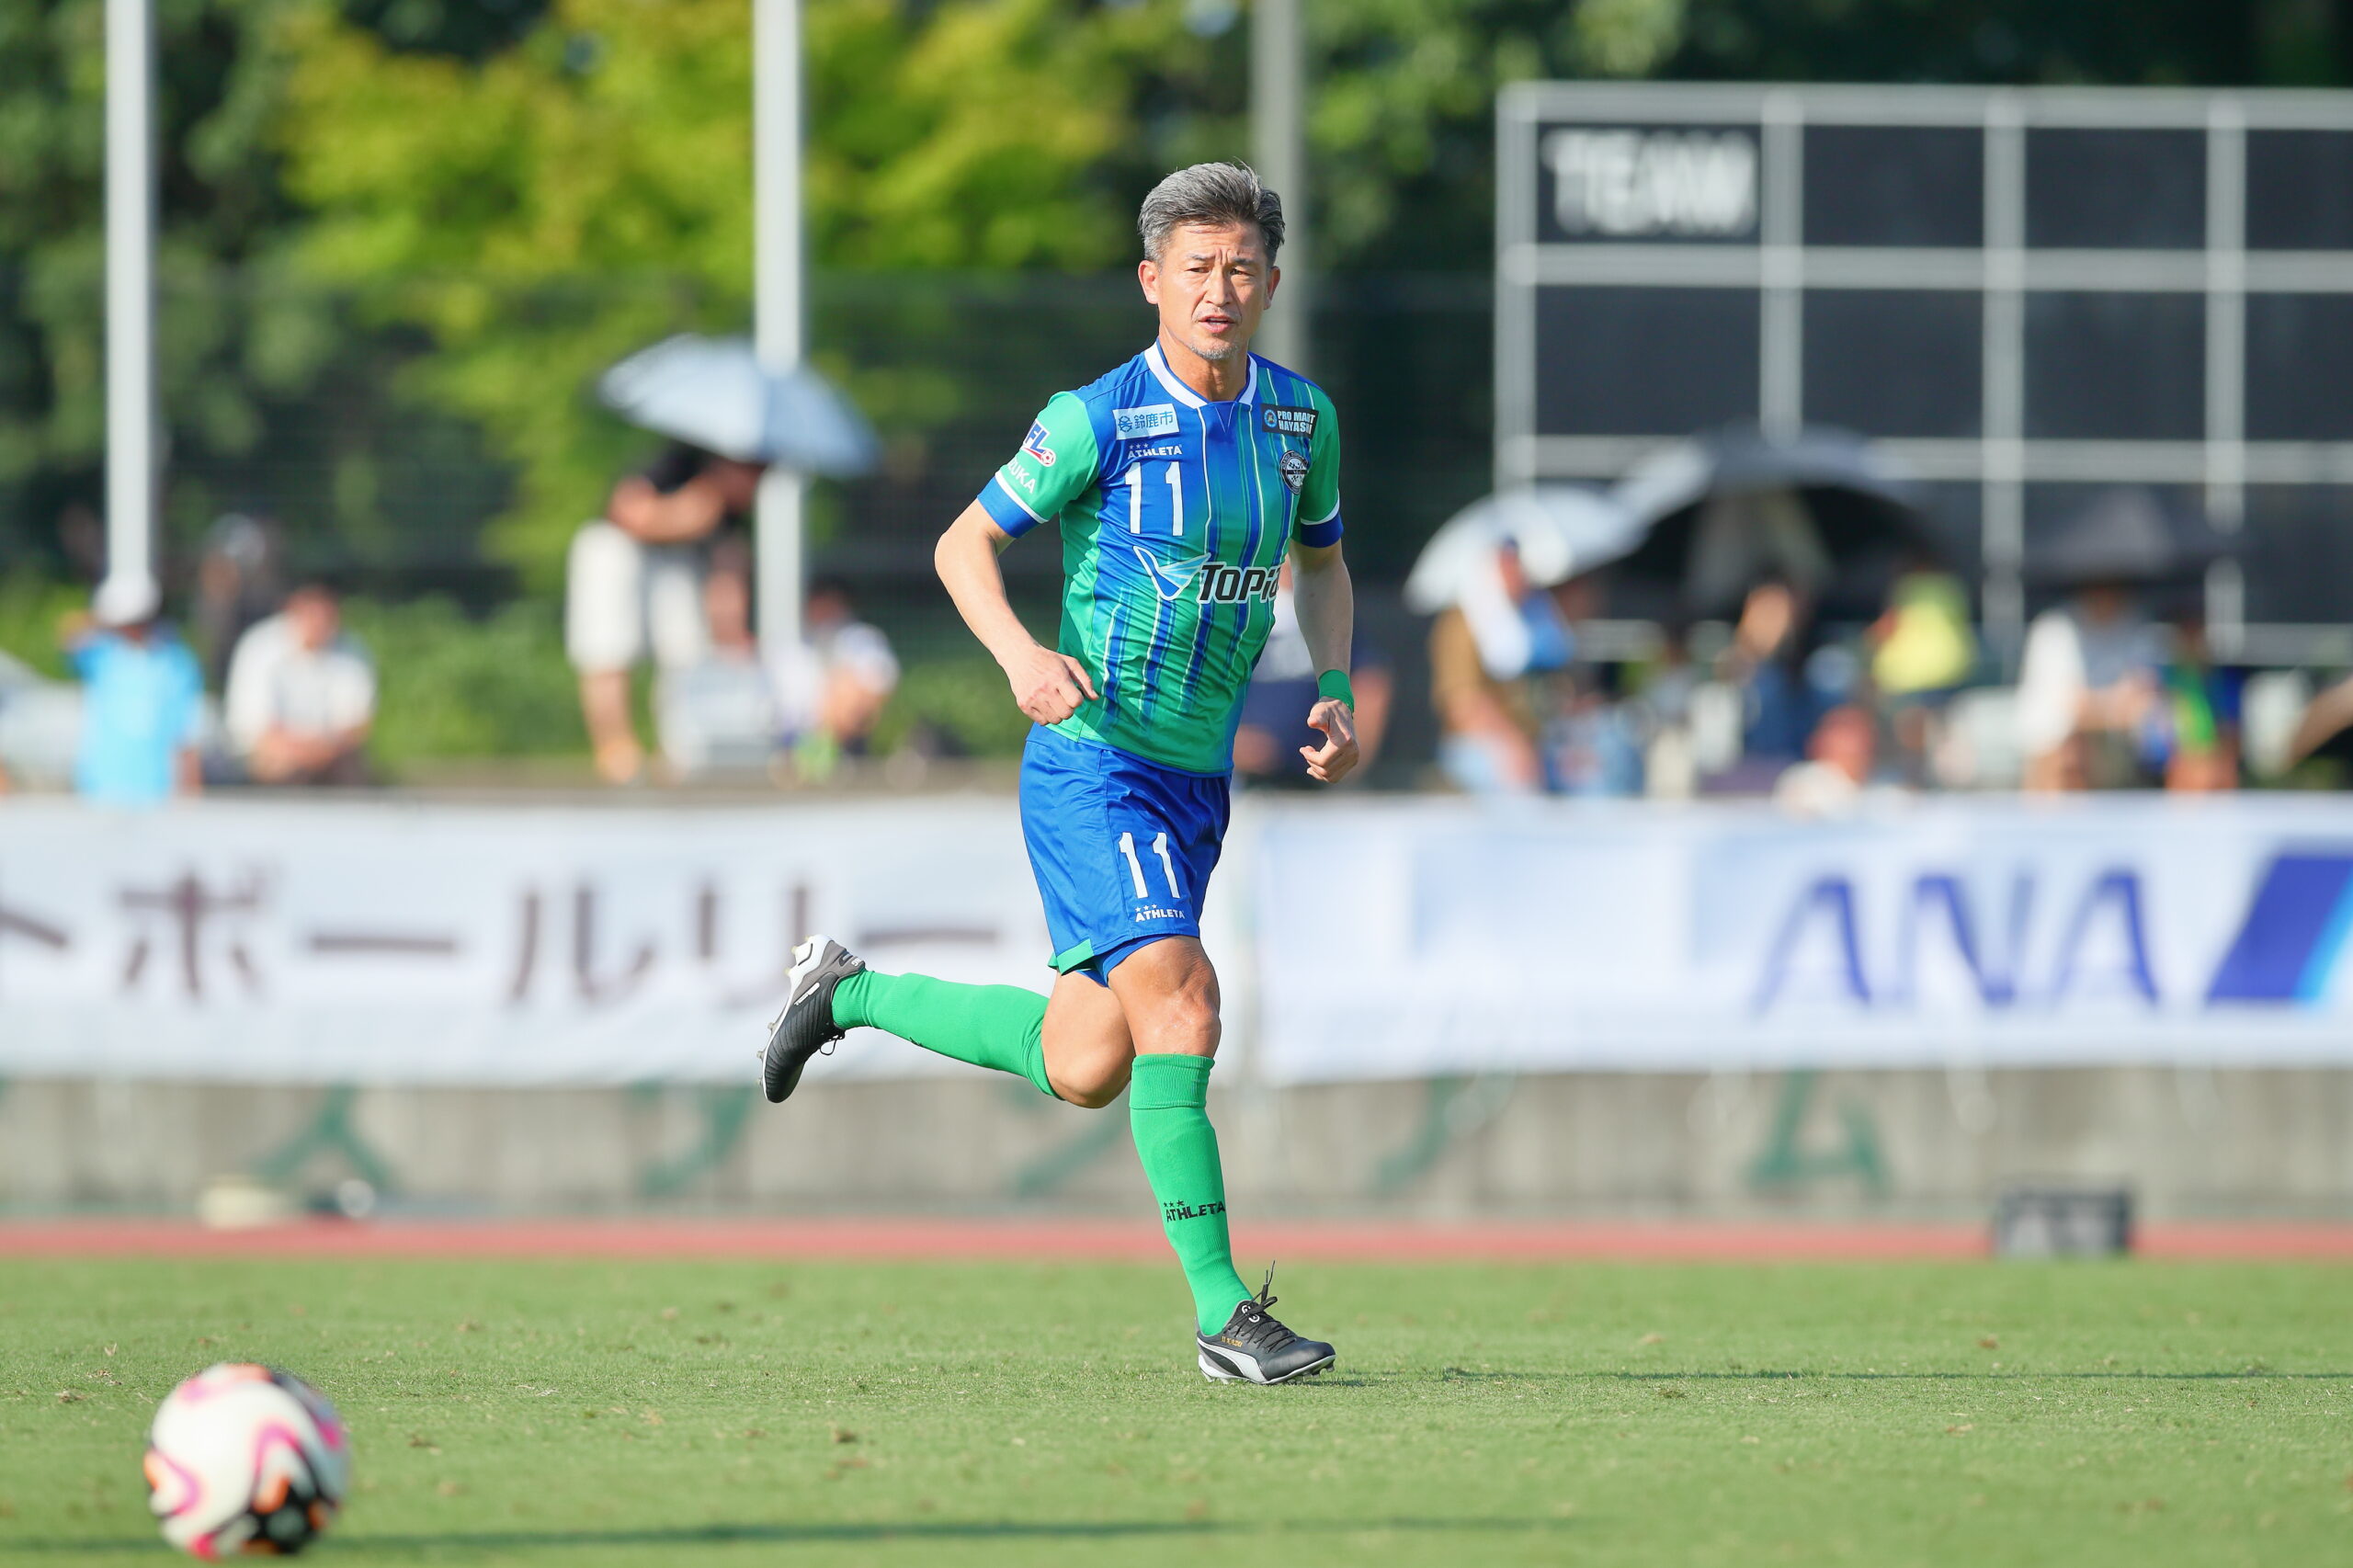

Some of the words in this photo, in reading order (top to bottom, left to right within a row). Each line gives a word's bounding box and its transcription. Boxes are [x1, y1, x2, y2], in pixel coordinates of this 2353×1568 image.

[1544, 129, 1757, 233] TEAM
[1134, 411, 1174, 429] 鈴鹿市
[1278, 410, 1292, 421] PRO
[1128, 445, 1183, 460] ATHLETA
[1125, 461, 1184, 537] 11
[1119, 832, 1181, 899] 11
[1135, 908, 1185, 923] ATHLETA
[1748, 866, 2160, 1009] ANA
[1165, 1200, 1226, 1223] ATHLETA
